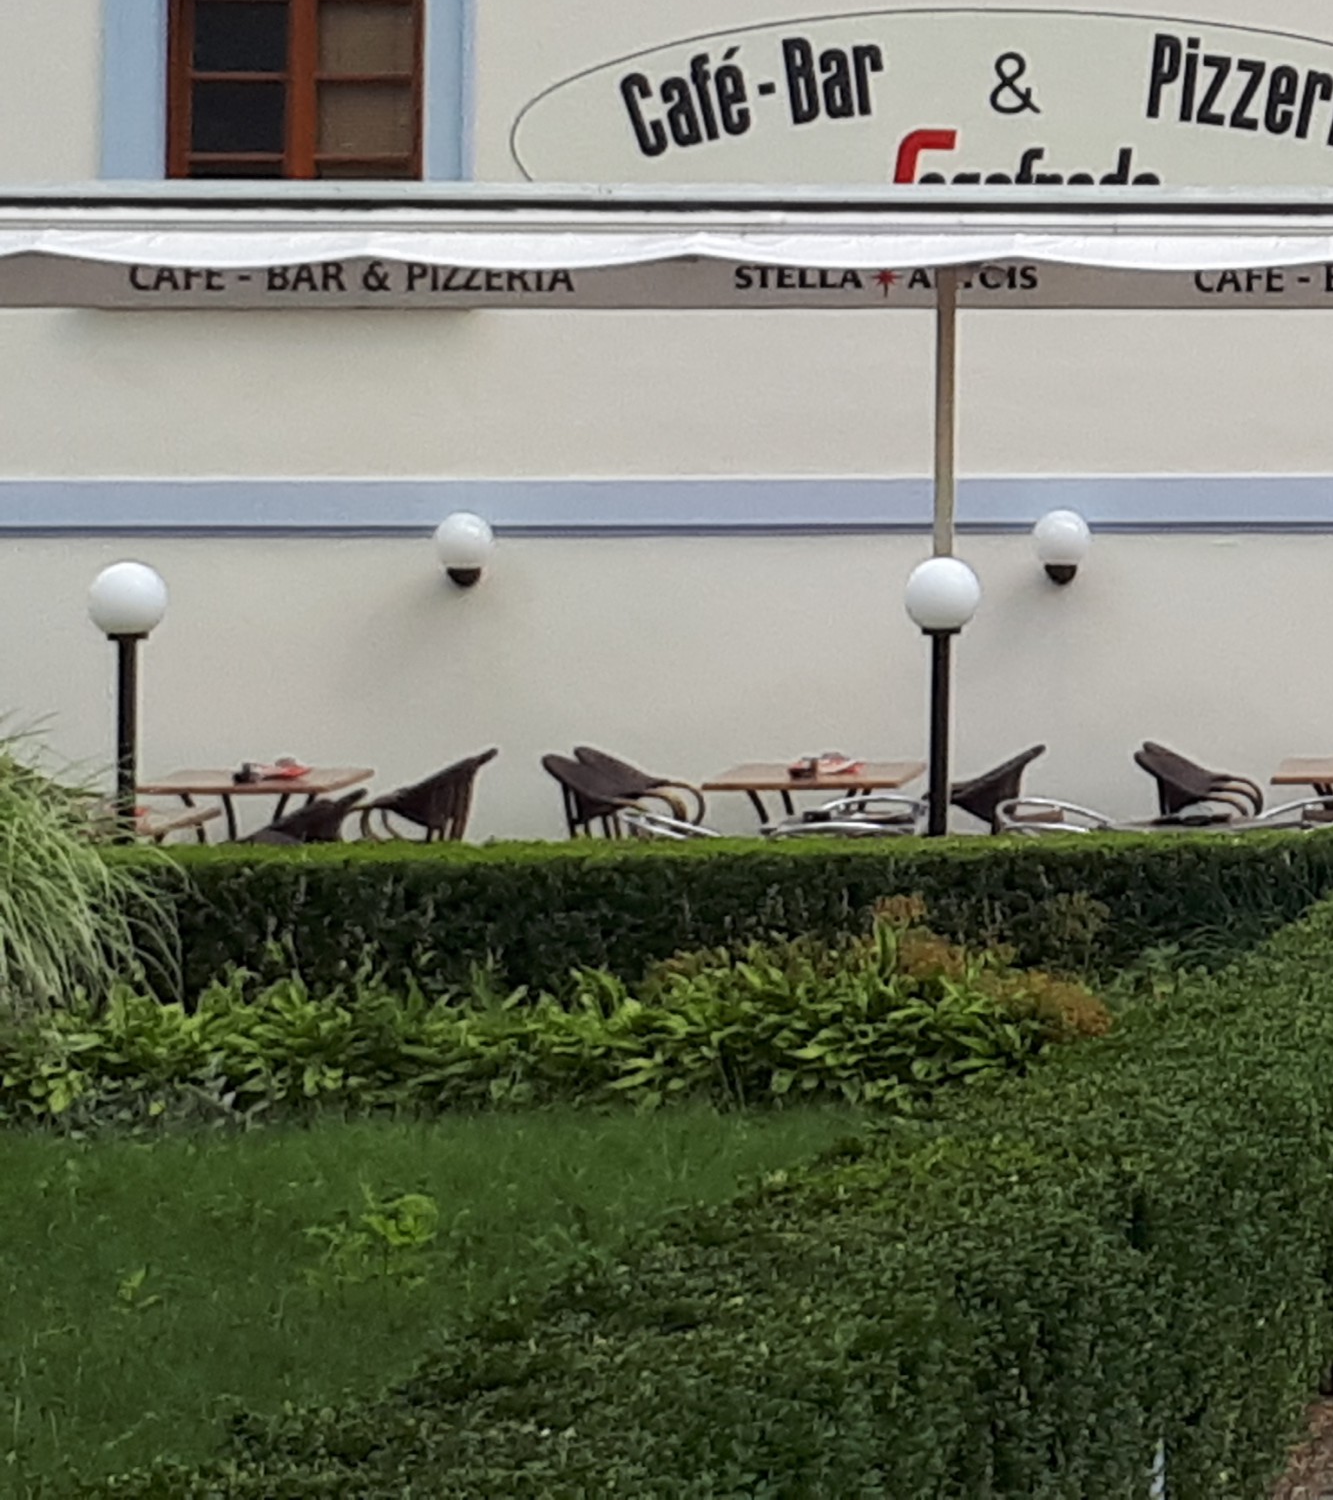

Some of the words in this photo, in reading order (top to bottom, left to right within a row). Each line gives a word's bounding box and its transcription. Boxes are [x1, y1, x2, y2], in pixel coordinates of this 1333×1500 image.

[988, 51, 1042, 114] &
[266, 261, 347, 292] BAR
[362, 260, 392, 292] &
[405, 262, 575, 292] PIZZERIA
[734, 265, 863, 290] STELLA
[907, 264, 1038, 290] AOIS
